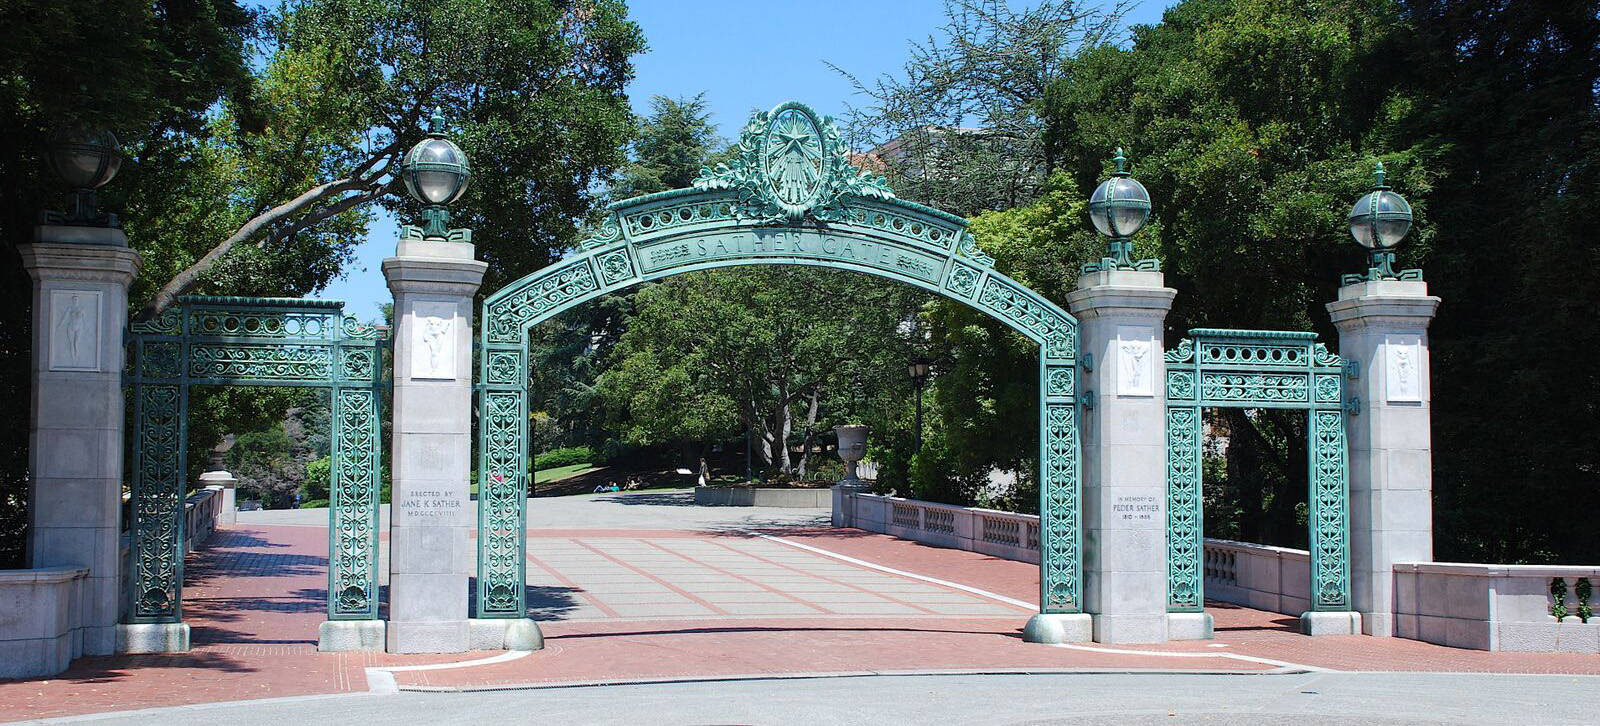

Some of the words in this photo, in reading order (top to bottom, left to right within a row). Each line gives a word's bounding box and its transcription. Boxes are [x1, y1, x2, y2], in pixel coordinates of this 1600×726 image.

[697, 234, 804, 256] SATHER
[822, 238, 890, 264] GATE
[1113, 504, 1134, 512] PEDER
[1136, 504, 1160, 512] SATHER
